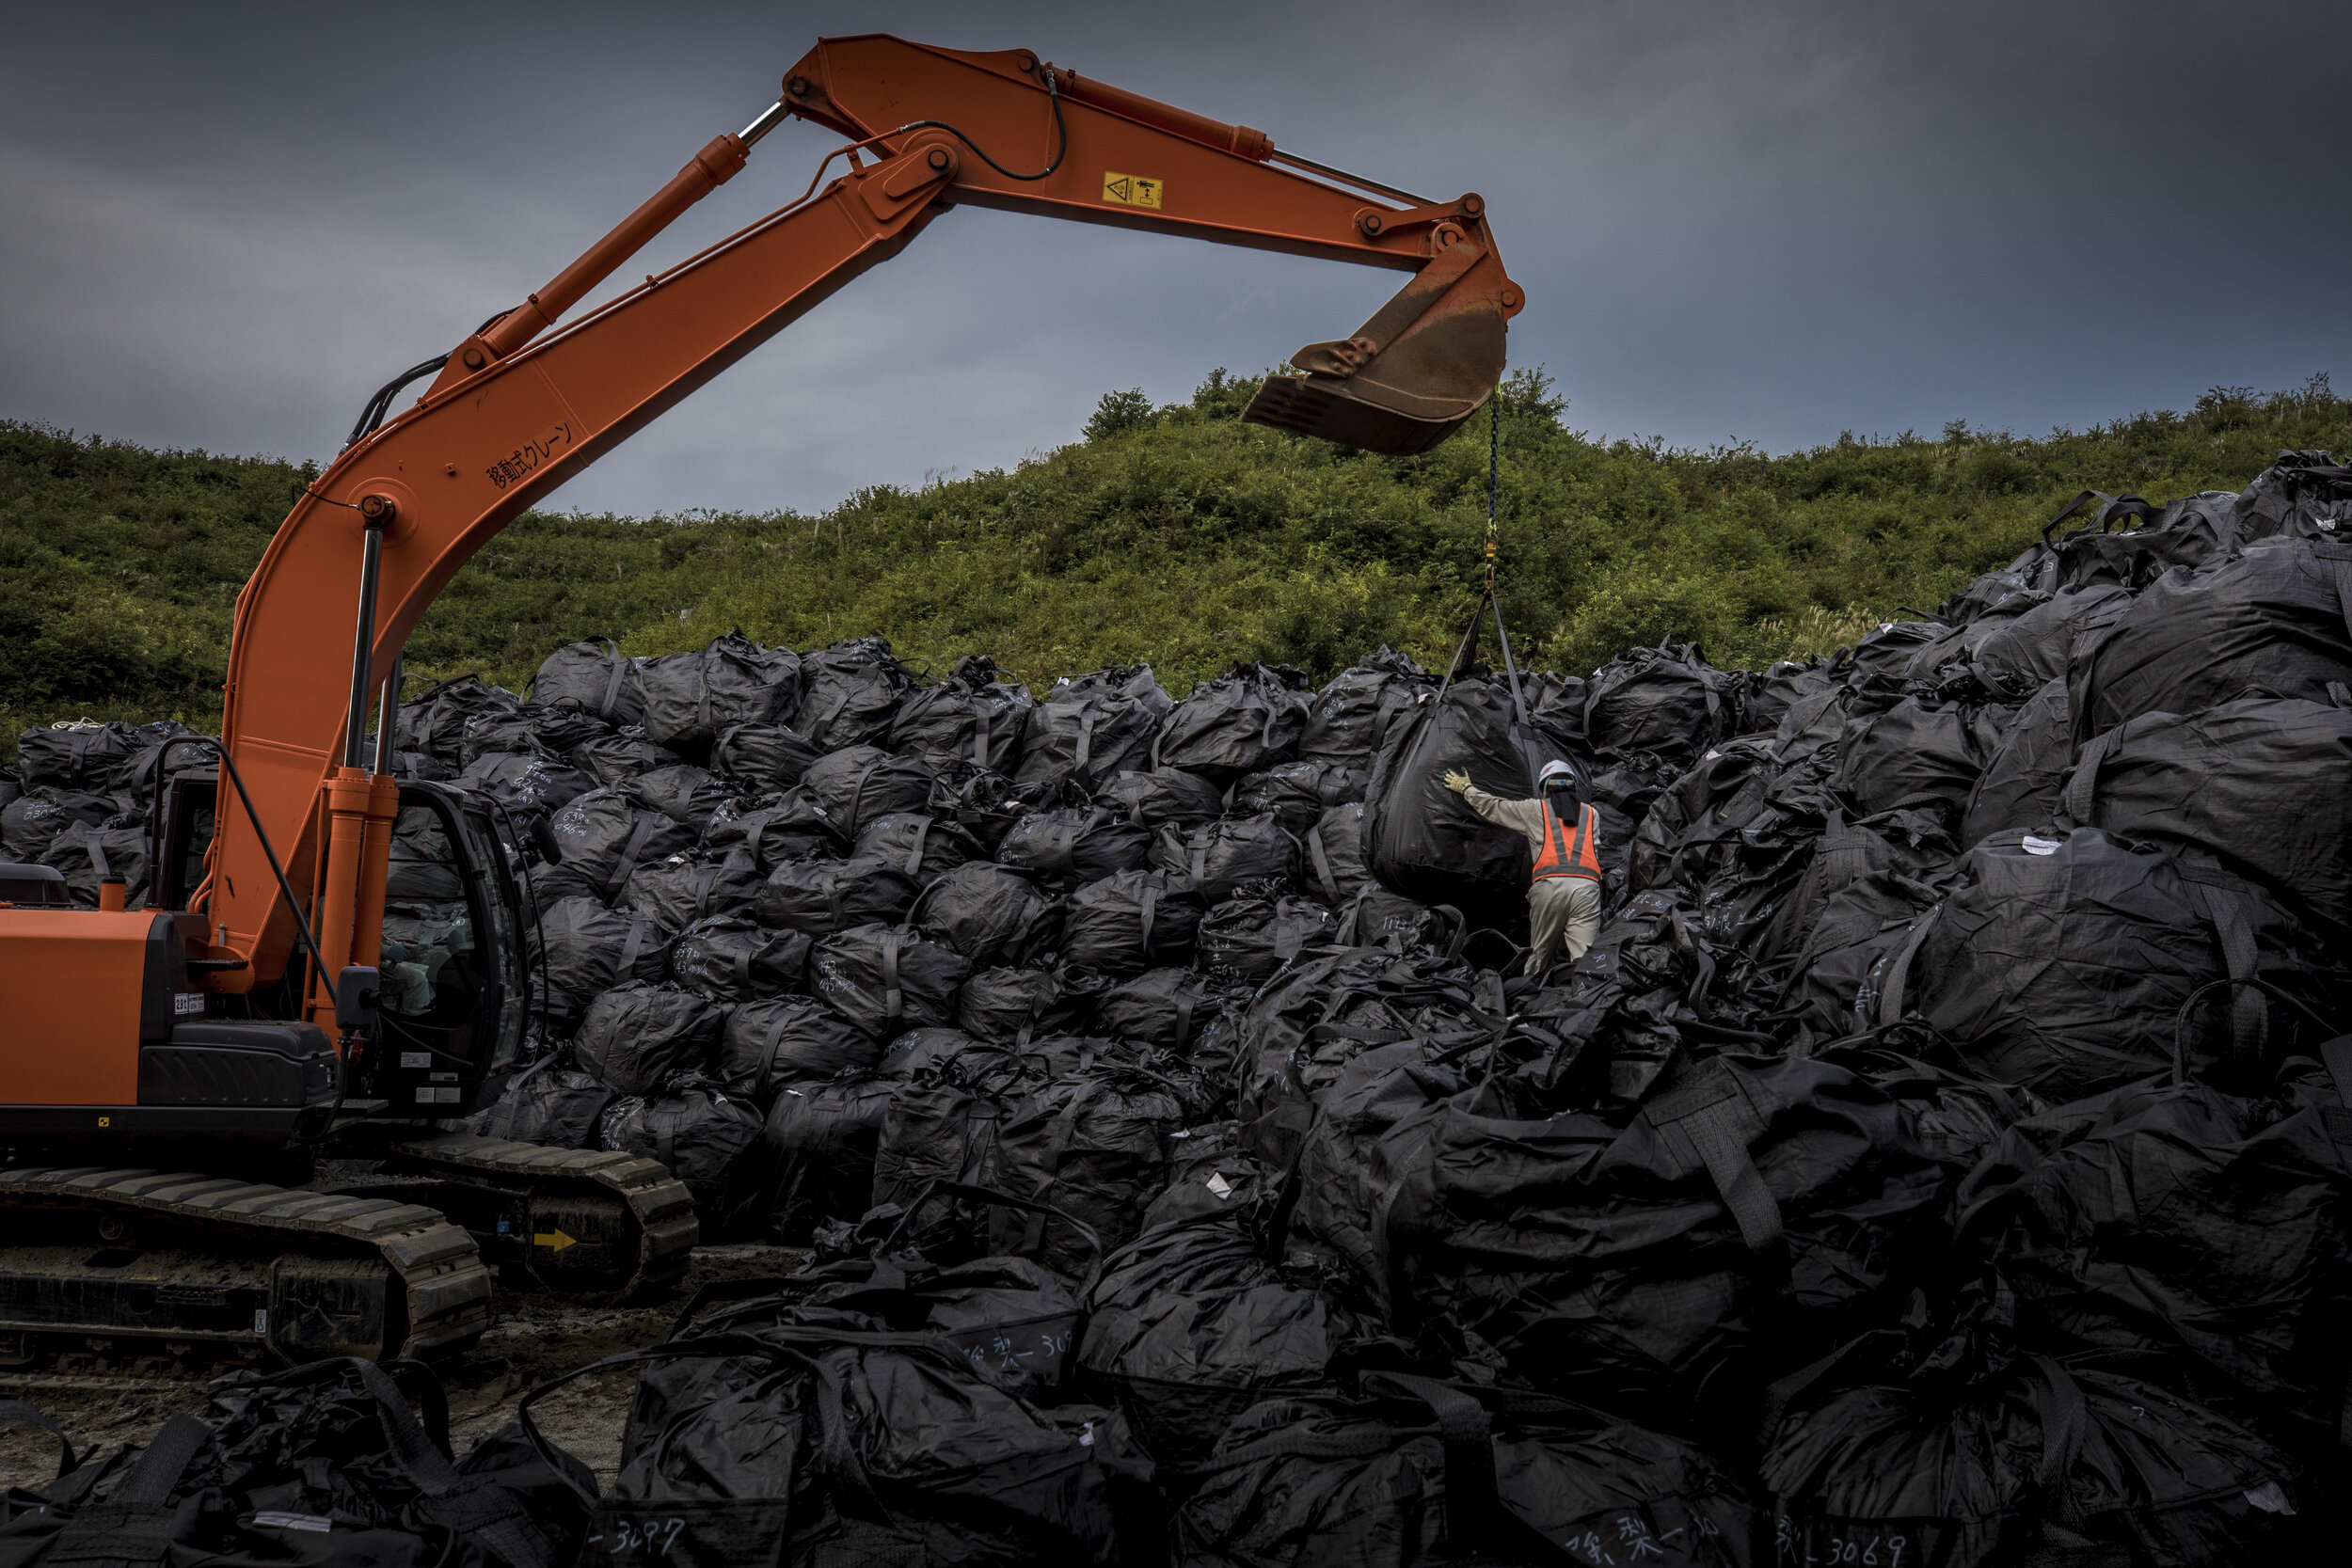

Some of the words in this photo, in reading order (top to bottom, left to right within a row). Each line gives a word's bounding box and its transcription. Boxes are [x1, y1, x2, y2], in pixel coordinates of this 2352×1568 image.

[485, 422, 571, 490] 移動式クレーン
[563, 811, 584, 825] 638
